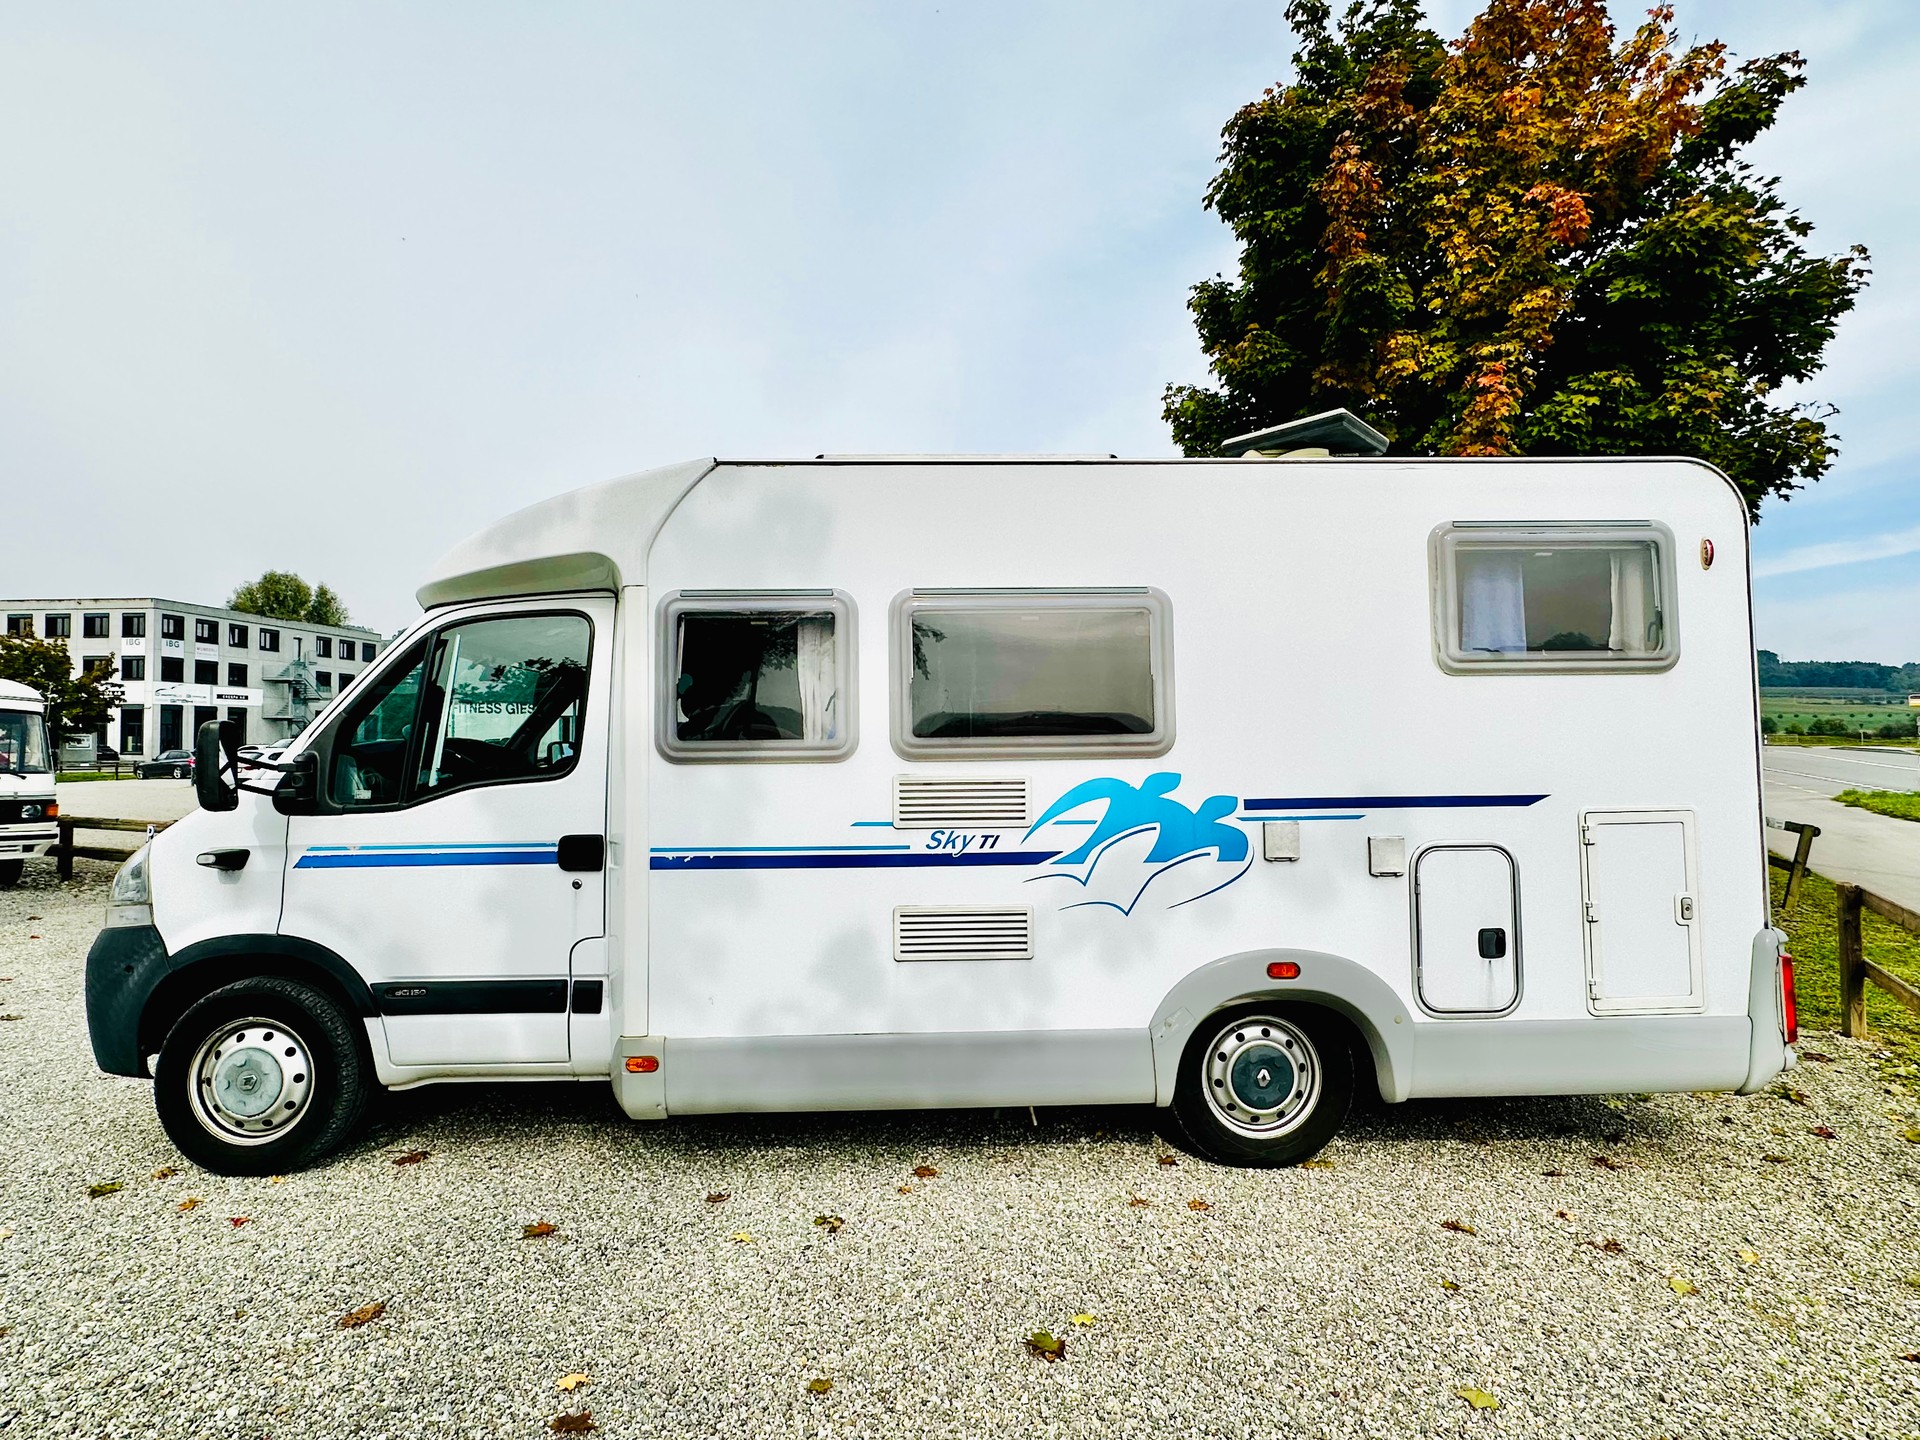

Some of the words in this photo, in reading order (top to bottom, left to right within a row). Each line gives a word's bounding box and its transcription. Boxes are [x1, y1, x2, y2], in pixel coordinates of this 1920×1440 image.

[125, 638, 141, 646] IBG
[165, 640, 180, 648] IBG
[925, 830, 976, 856] Sky
[979, 834, 1000, 849] TI
